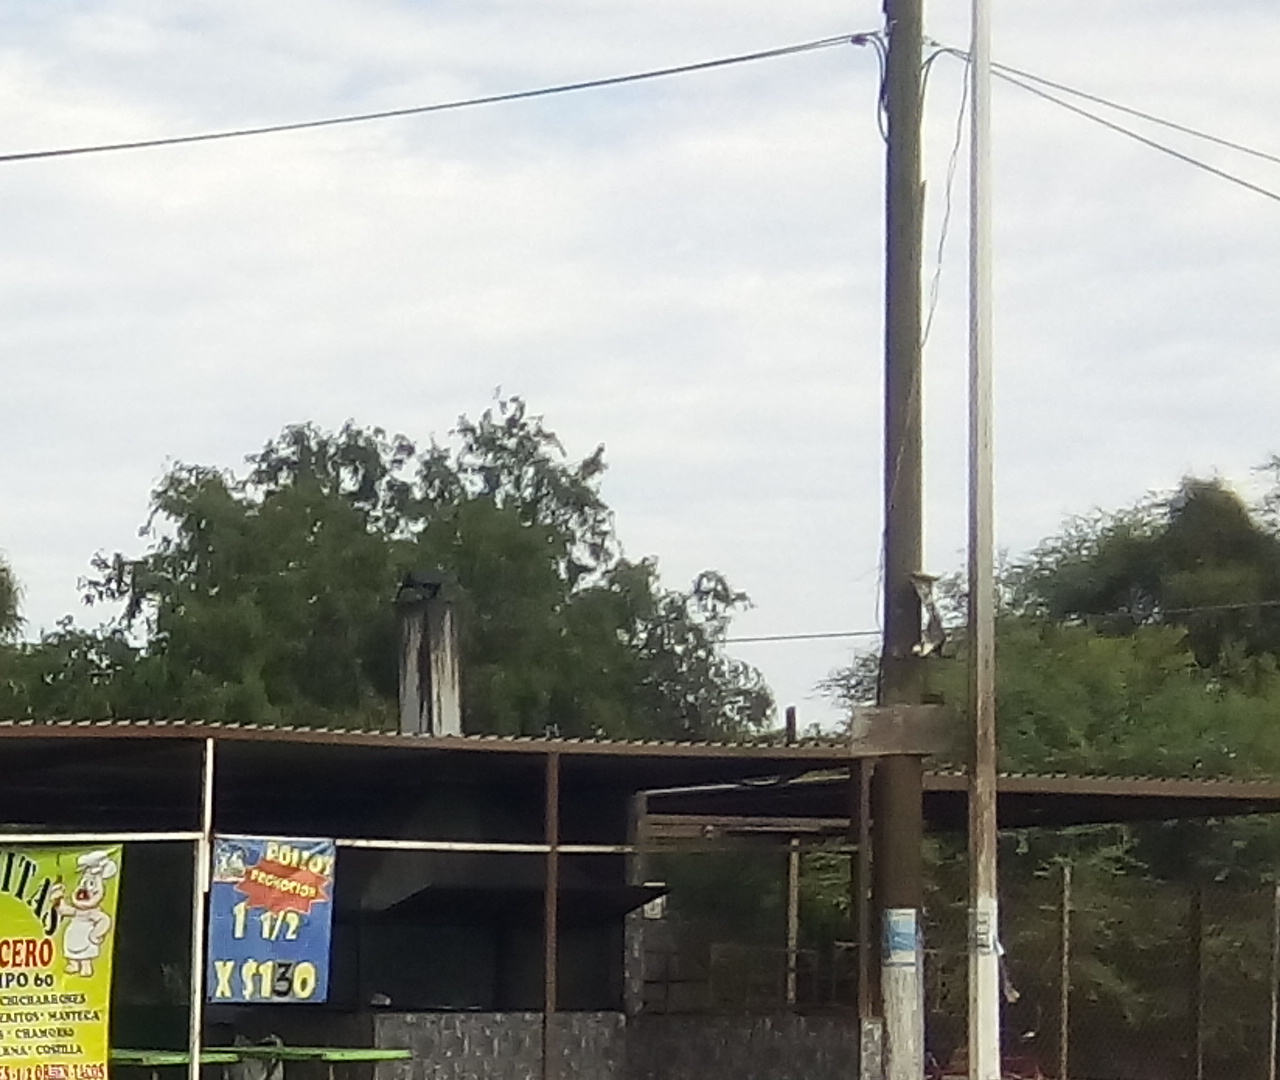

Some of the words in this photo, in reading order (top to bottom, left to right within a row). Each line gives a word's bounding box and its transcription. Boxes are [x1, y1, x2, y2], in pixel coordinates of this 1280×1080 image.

[233, 901, 246, 938] 1
[260, 910, 300, 940] 1/2
[33, 973, 54, 987] 60
[214, 960, 235, 998] X
[241, 958, 316, 1000] $130
